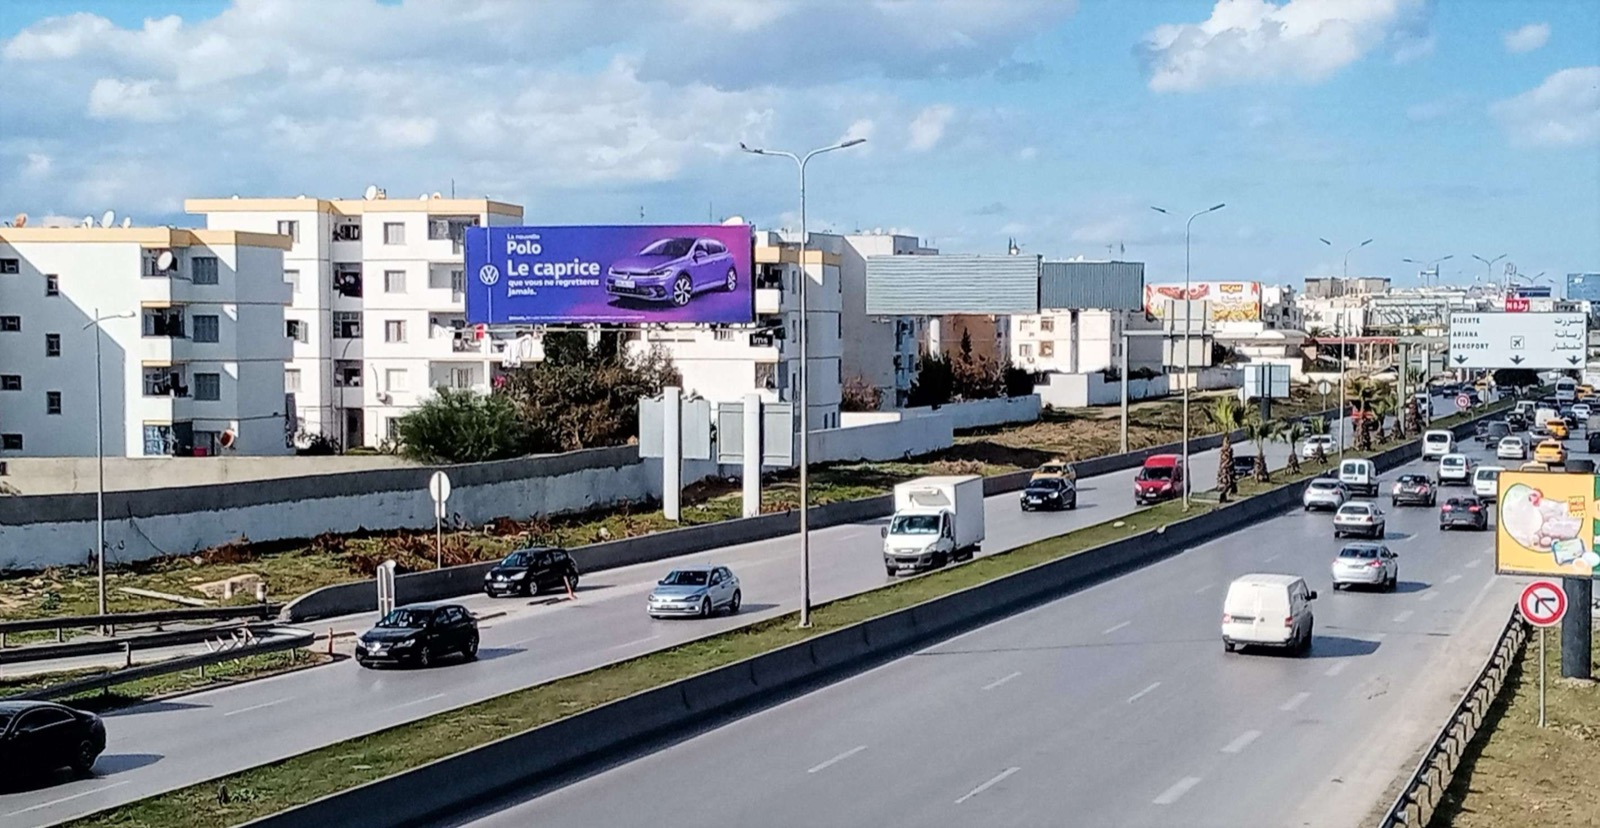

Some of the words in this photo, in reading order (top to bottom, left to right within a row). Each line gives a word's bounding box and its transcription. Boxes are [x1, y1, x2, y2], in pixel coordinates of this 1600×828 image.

[507, 240, 542, 255] Polo
[507, 259, 530, 276] Le
[533, 258, 601, 280] caprice
[508, 280, 523, 288] que
[556, 278, 600, 288] regretterez
[508, 287, 537, 297] jamais.
